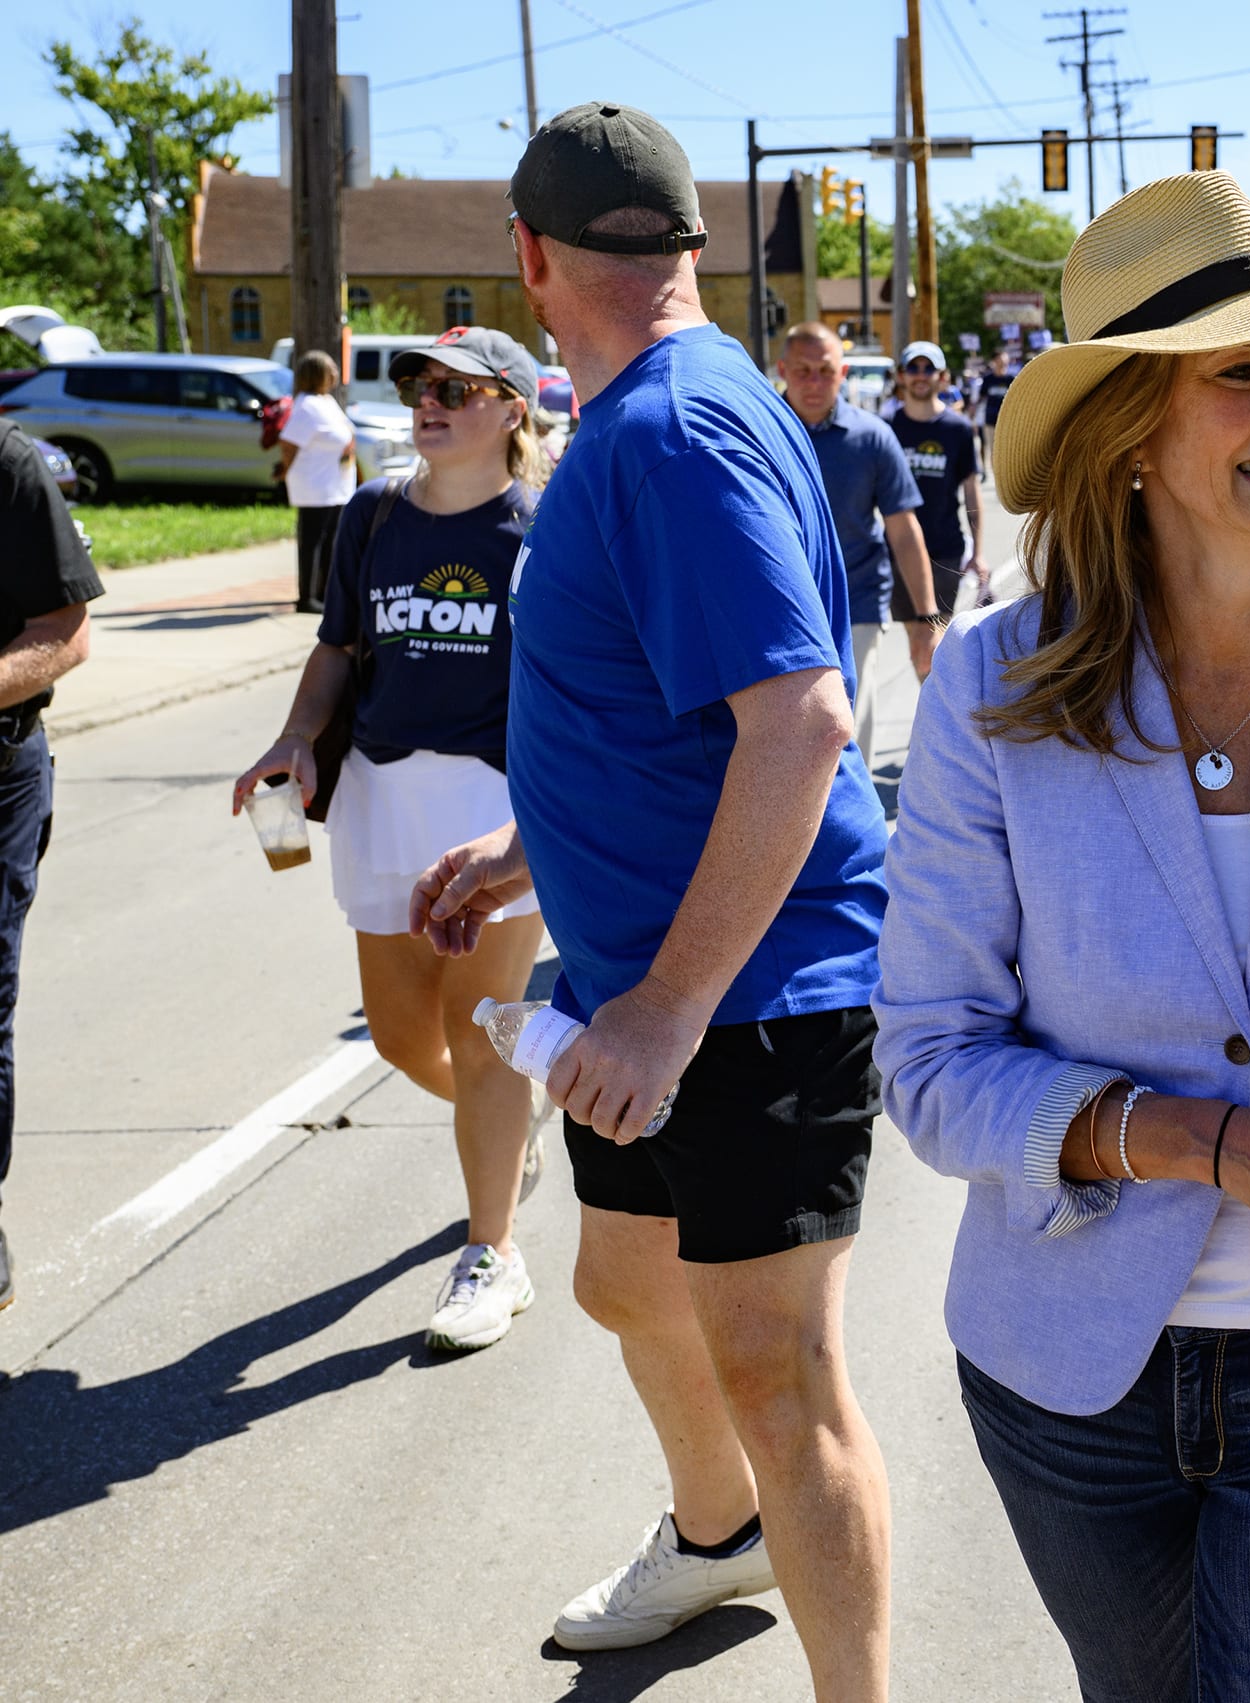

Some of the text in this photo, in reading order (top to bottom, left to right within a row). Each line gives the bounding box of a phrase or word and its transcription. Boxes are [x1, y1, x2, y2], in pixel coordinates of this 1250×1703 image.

[369, 584, 415, 601] DR. AMY
[375, 596, 498, 636] ACTON
[409, 639, 490, 654] FOR GOVERNOR
